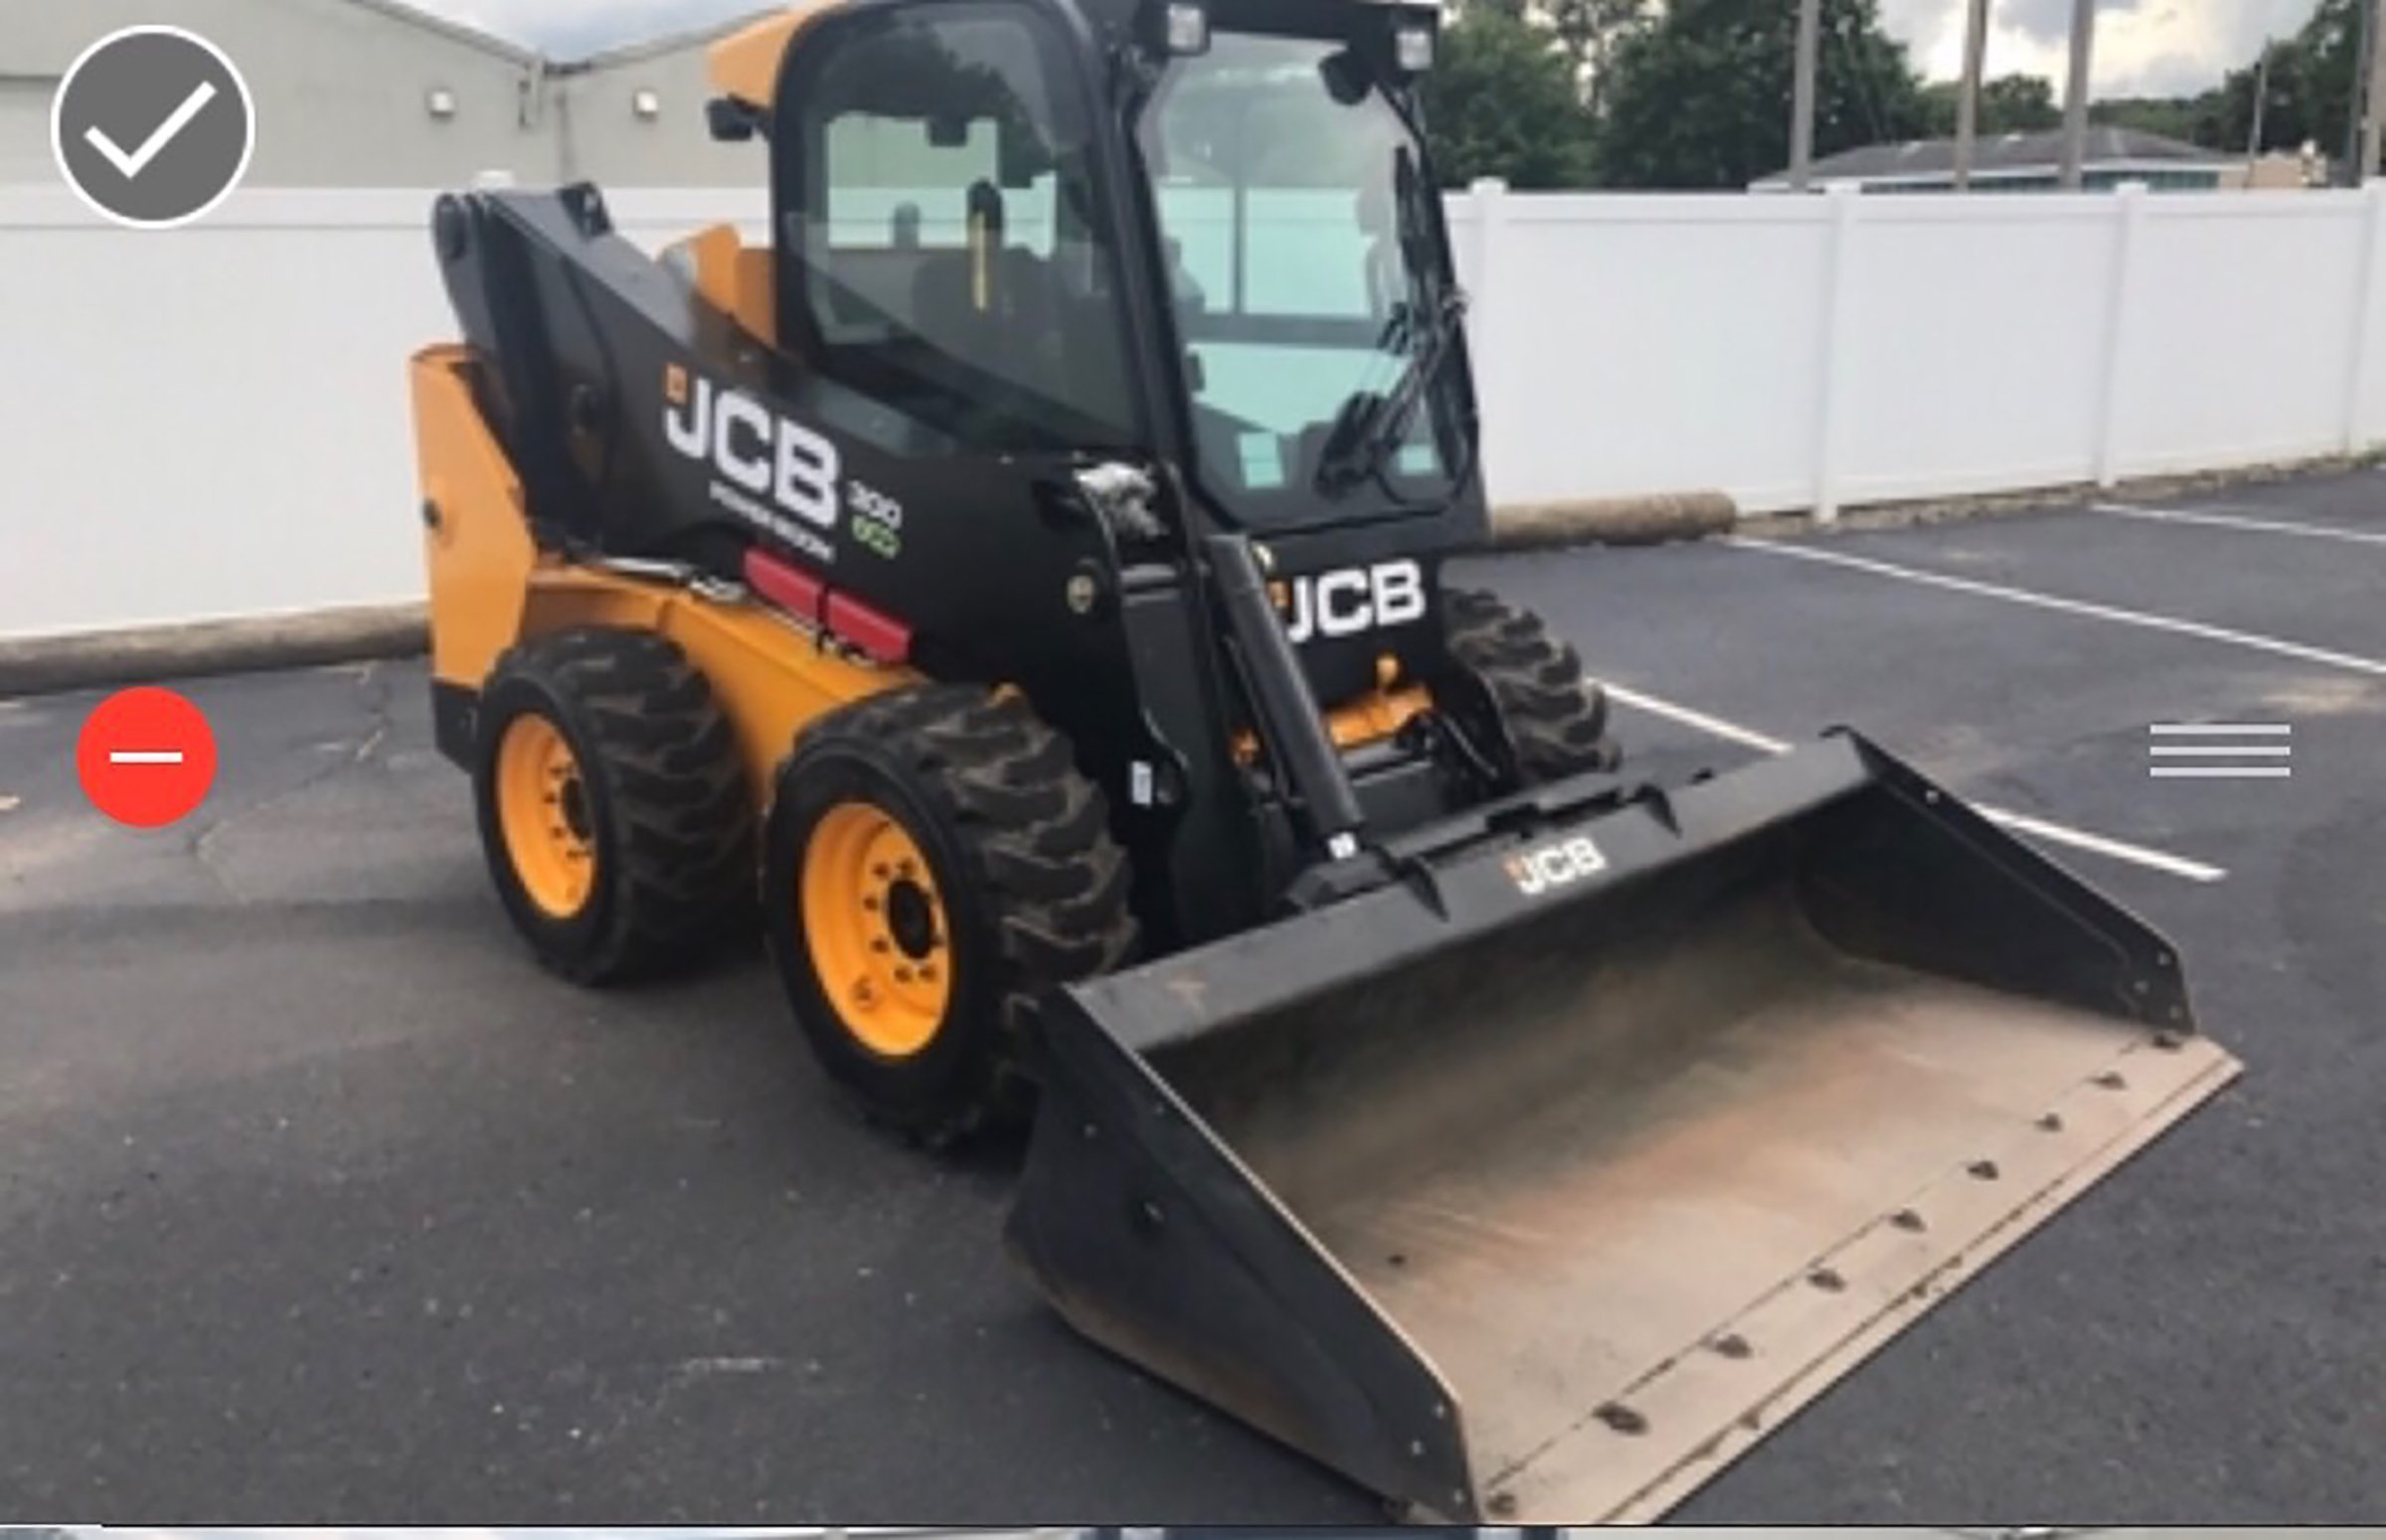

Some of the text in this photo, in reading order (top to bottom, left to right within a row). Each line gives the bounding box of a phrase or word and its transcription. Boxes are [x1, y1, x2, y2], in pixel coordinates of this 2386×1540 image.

[664, 374, 841, 528] JCB
[1286, 559, 1427, 644] JCB
[1517, 837, 1607, 895] JCB
